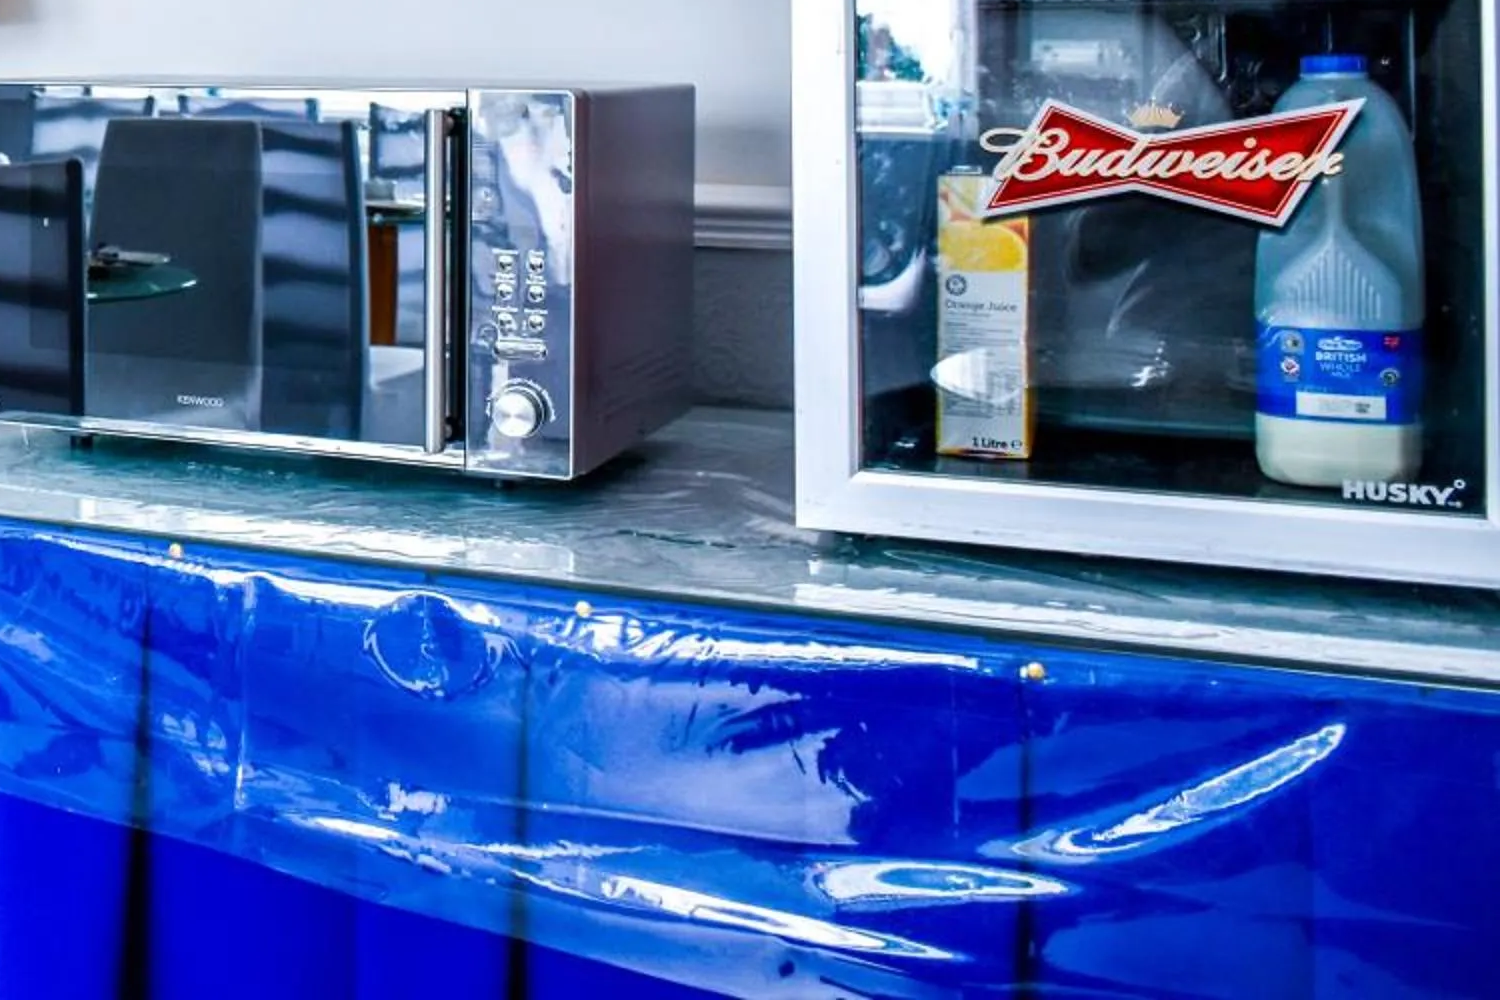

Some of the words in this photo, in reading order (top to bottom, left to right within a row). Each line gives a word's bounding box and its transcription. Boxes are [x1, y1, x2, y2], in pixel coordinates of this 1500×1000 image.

[979, 126, 1344, 184] Budweiser
[946, 301, 985, 312] Orange
[987, 301, 1018, 312] Juice
[1315, 351, 1367, 363] BRITISH
[1320, 362, 1361, 372] WHOLE
[177, 394, 224, 407] KENWOOD
[972, 436, 979, 448] 1
[982, 437, 1008, 449] Litre
[1342, 479, 1455, 506] HUSKY
